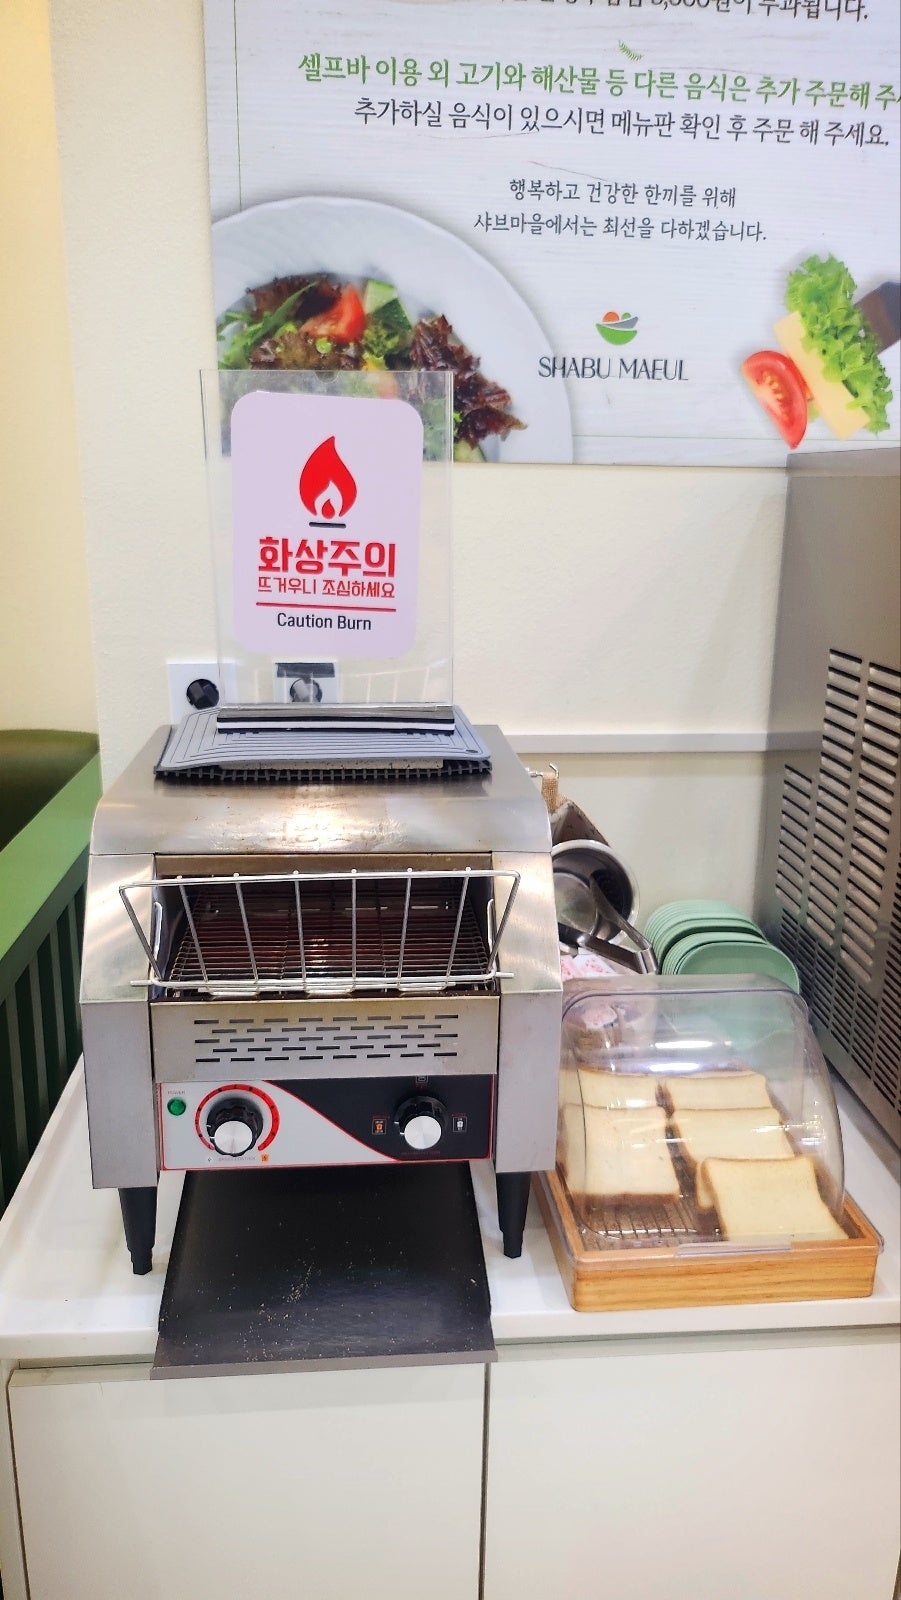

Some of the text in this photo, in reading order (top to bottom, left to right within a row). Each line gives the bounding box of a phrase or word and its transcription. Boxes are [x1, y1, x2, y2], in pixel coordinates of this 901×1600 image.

[298, 53, 900, 110] 셀프바 이용 외 고기와 해산물 등 다른 음식은 추가 주문해 주
[355, 97, 442, 127] 추가하실
[448, 103, 512, 131] 음식이
[521, 105, 604, 134] 있으시면
[612, 110, 675, 137] 메뉴판
[680, 113, 720, 140] 확인
[727, 115, 747, 142] 후
[753, 118, 794, 143] 주문
[800, 120, 819, 145] 해
[510, 179, 735, 208] 행복하고 건강한 한끼를 위해
[474, 211, 766, 242] 샤브마을에서는 최선을 다하겠습니다.
[538, 356, 688, 380] SHABU MAEUL
[258, 536, 395, 577] 화상주의
[258, 577, 395, 598] 뜨거우니 조심하세요
[278, 613, 371, 630] Caution Burn
